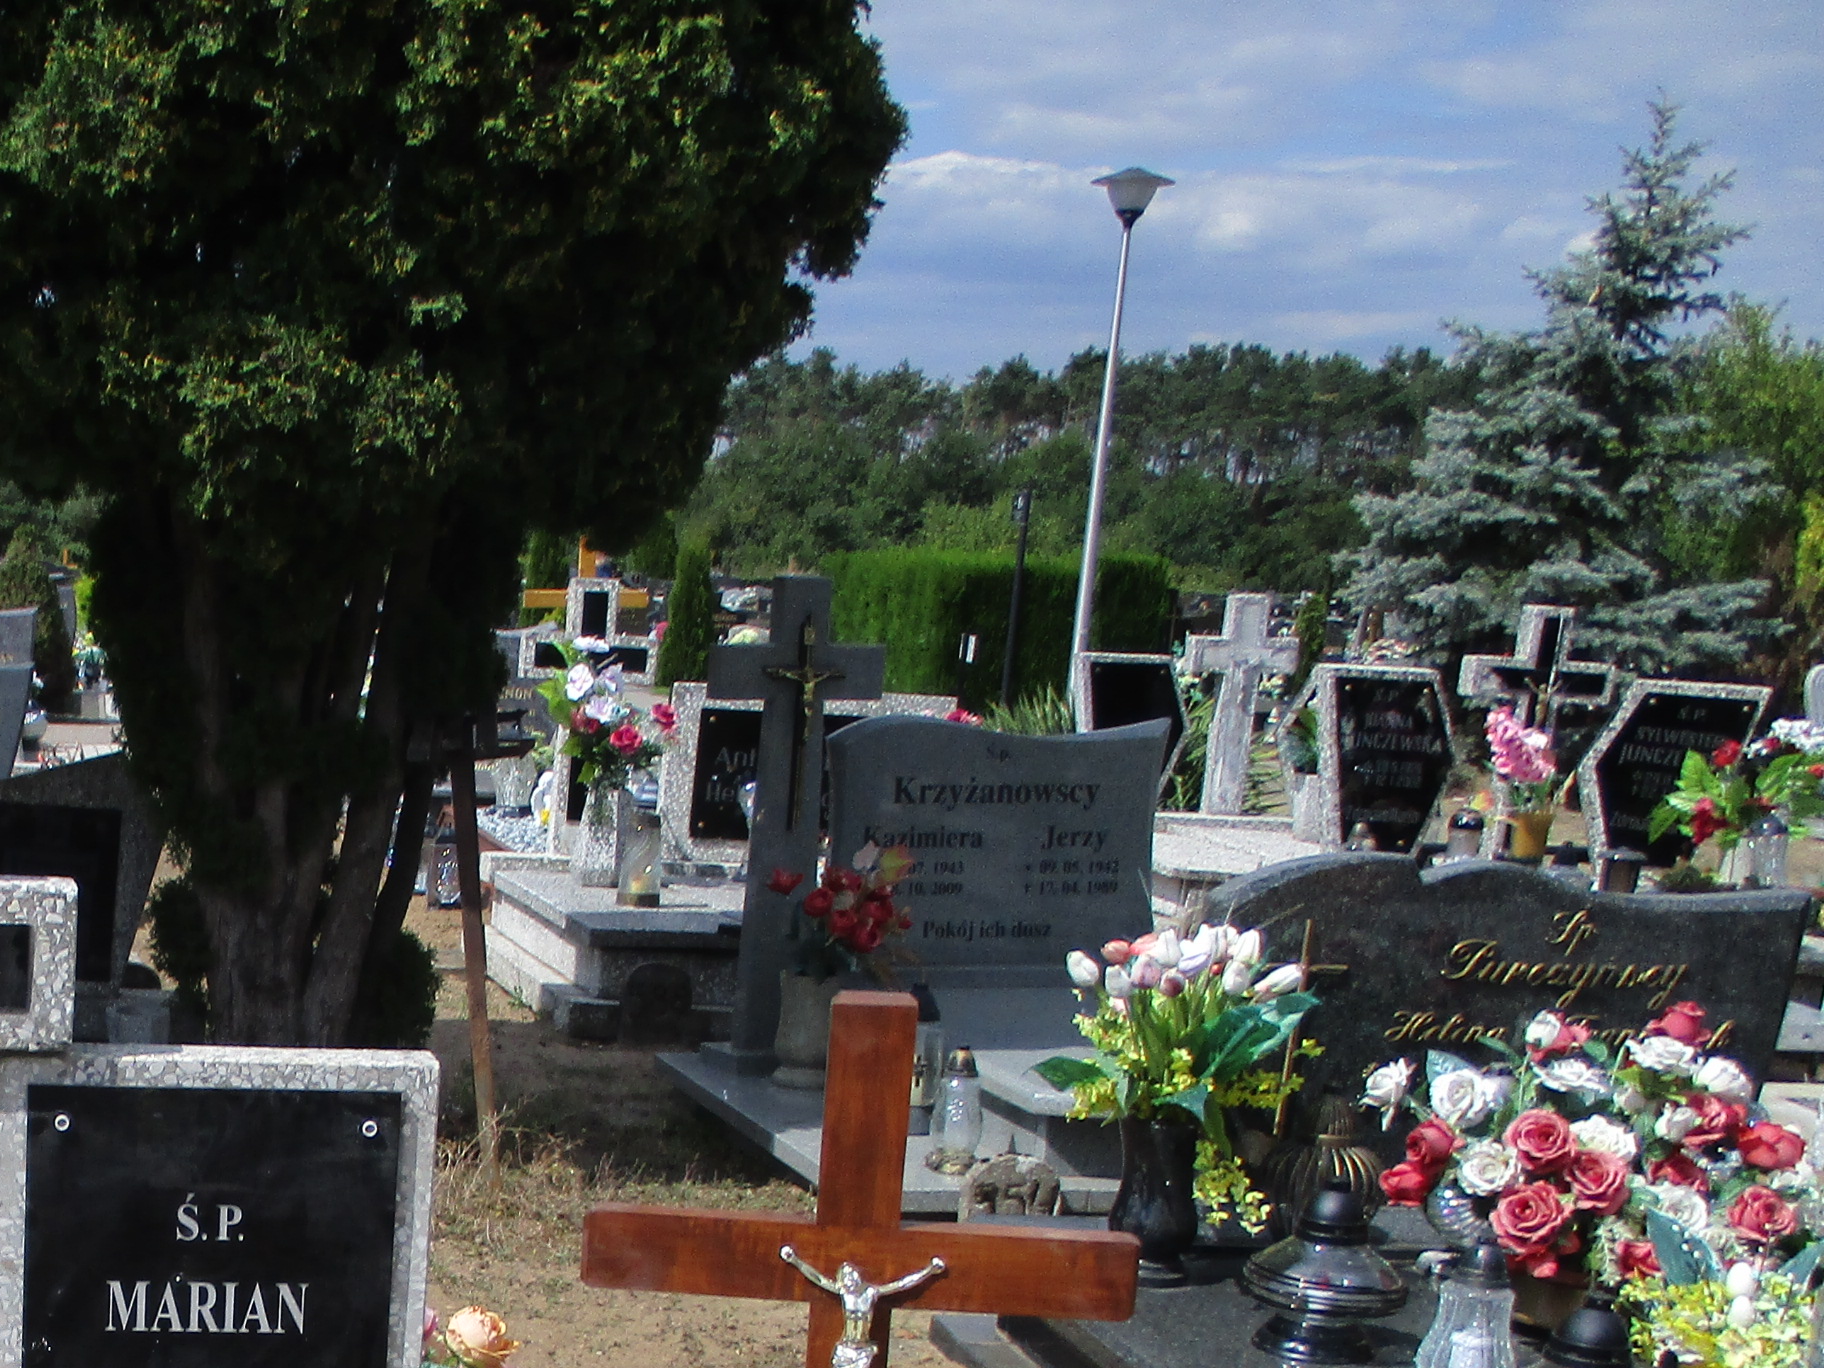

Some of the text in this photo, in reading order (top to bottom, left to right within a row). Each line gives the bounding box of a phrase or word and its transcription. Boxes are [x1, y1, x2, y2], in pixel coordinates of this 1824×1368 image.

[893, 775, 1101, 811] Krzyżanowscy
[863, 824, 984, 850] Kazimiera
[1040, 824, 1107, 851] Jerzy
[1010, 919, 1052, 938] dusz
[176, 1192, 244, 1243] Ś.P.
[105, 1279, 310, 1336] MARIAN
